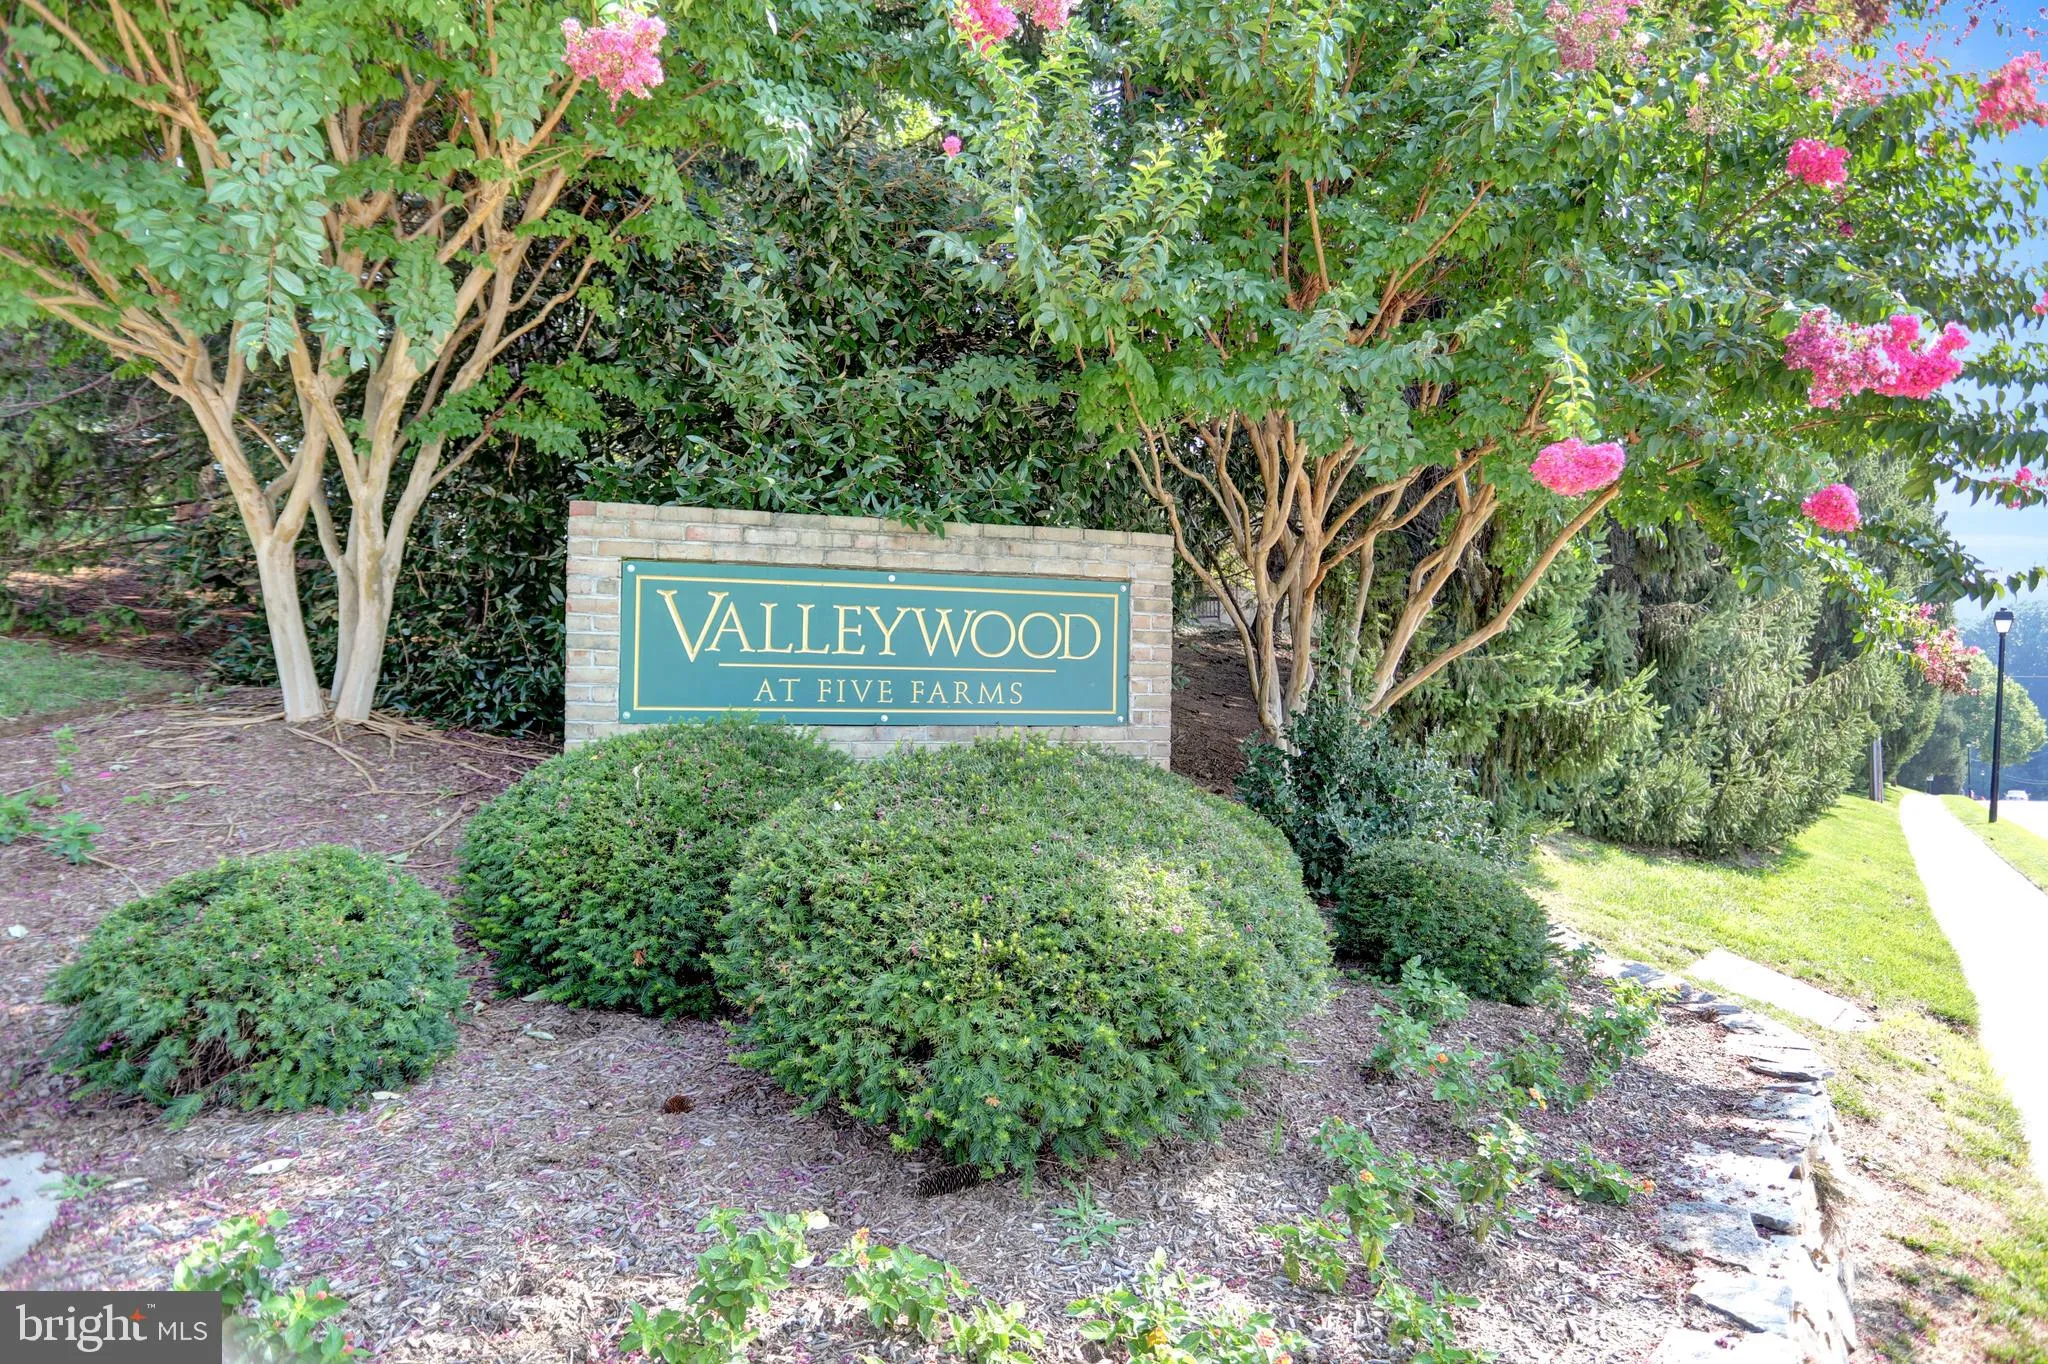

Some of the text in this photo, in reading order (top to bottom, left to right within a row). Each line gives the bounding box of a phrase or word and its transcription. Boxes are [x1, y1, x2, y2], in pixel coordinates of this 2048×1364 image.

[656, 588, 1102, 662] VALLEYWOOD
[753, 677, 1024, 705] AT FIVE FARMS
